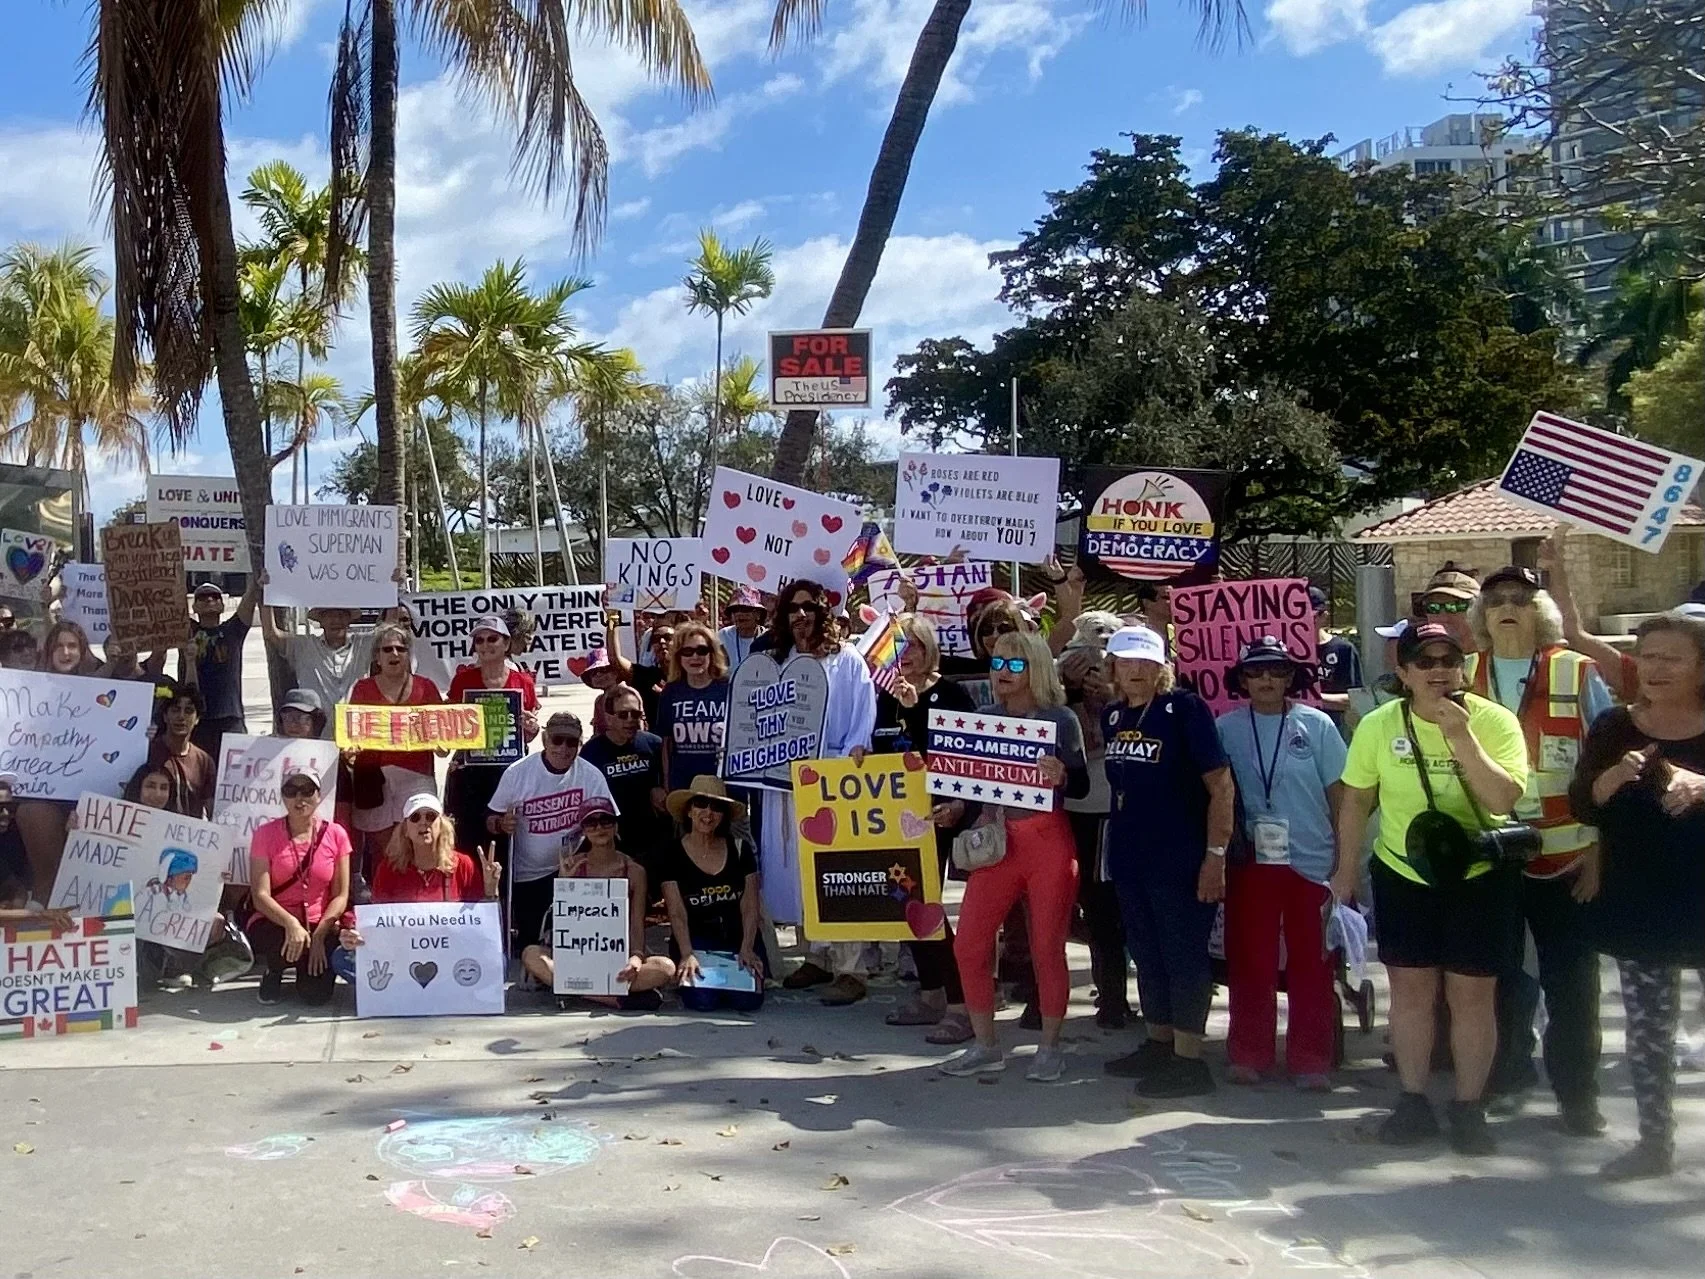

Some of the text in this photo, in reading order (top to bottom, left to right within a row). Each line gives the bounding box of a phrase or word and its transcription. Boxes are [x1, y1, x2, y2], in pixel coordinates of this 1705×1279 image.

[792, 335, 848, 356] FOR
[780, 357, 863, 376] SALE
[931, 469, 999, 482] ROSES ARE RED
[158, 489, 240, 503] LOVE & UNI
[747, 483, 782, 508] LOVE
[953, 487, 1039, 504] VIOLETS ARE BLUE
[1641, 464, 1692, 545] 8647
[276, 508, 310, 528] LOVE
[911, 509, 931, 521] WANT
[936, 511, 947, 522] TO
[1101, 498, 1186, 519] HONK
[935, 528, 952, 539] HOW
[960, 530, 988, 541] ABOUT
[1113, 519, 1202, 535] IF YOU LOVE
[181, 545, 235, 562] HATE
[309, 533, 382, 554] SUPERMAN
[631, 540, 672, 565] NO
[764, 534, 792, 556] NOT
[1087, 539, 1207, 560] DEMOCRACY
[309, 563, 339, 580] WAS
[619, 563, 695, 587] KINGS
[413, 597, 467, 617] THE
[541, 591, 600, 610] THIN
[1174, 583, 1306, 625] STAYING
[529, 635, 576, 653] ATE
[582, 632, 604, 650] IS
[1280, 622, 1311, 660] IS
[0, 686, 91, 719] Make
[672, 701, 725, 718] TEAM
[673, 721, 725, 744] DWS
[757, 711, 788, 738] THY
[8, 722, 98, 761] Empathy
[487, 726, 517, 748] FF
[933, 734, 1046, 759] PRO-AMERICA
[0, 750, 83, 776] Great
[607, 760, 650, 775] DELMAY
[930, 757, 1050, 785] ANTI-TRUMP
[820, 772, 907, 801] LOVE
[525, 792, 581, 814] DISSENT IS
[84, 797, 151, 838] HATE
[851, 808, 886, 836] IS
[164, 823, 220, 850] NEVER
[68, 839, 128, 867] MADE
[823, 872, 888, 884] STRONGER
[823, 884, 888, 897] THAN HATE
[376, 914, 481, 928] All You Need Is
[555, 900, 619, 921] Impeach
[150, 910, 211, 946] GREAT
[411, 936, 449, 950] LOVE
[555, 929, 625, 955] Imprison
[8, 939, 110, 973] HATE
[60, 969, 100, 984] MAKE
[106, 967, 125, 979] US
[4, 981, 114, 1016] GREAT
